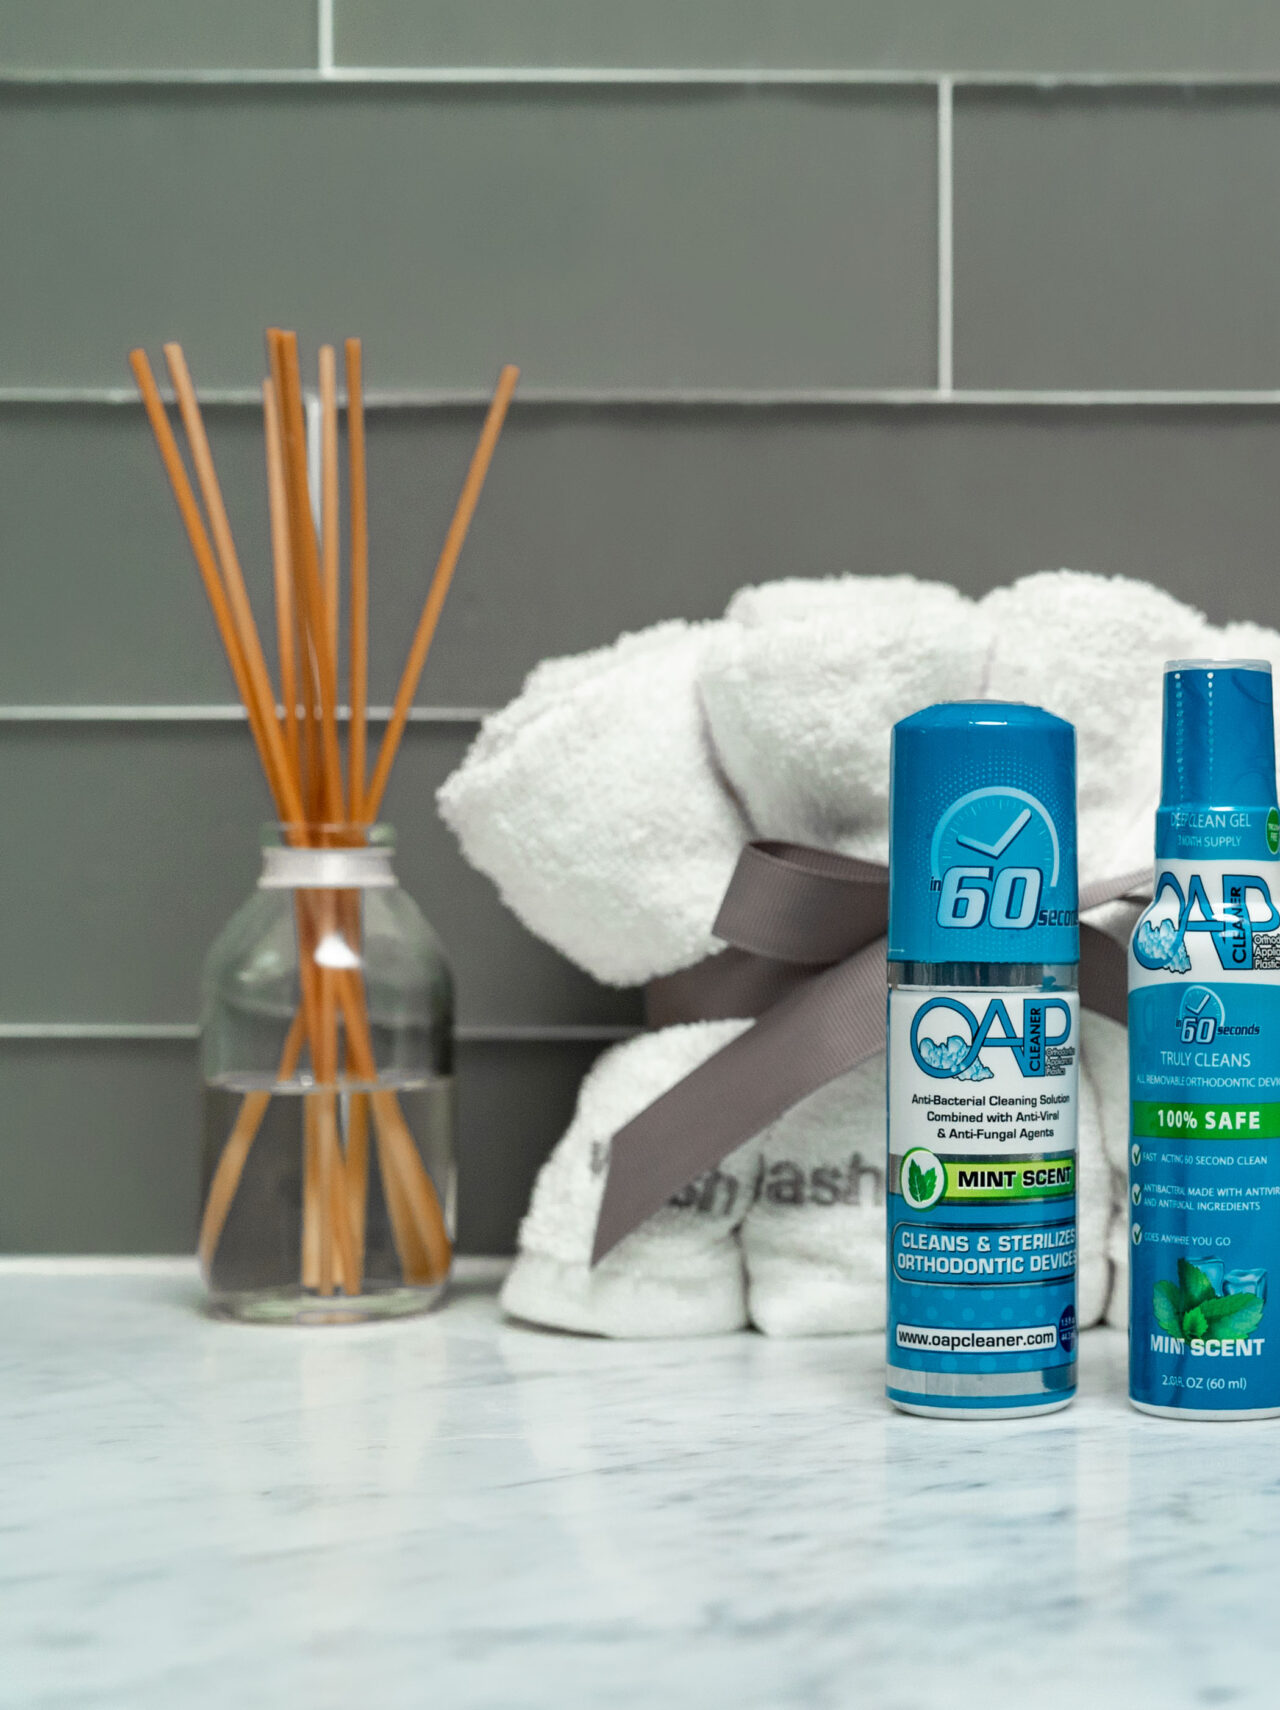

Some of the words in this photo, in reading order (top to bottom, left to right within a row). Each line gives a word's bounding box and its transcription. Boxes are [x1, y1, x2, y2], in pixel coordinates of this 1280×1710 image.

[1189, 814, 1227, 828] CLEAN
[1230, 813, 1251, 828] GEL
[1204, 836, 1242, 848] SUPPLY
[930, 876, 941, 892] in
[936, 866, 1043, 929] 60
[1133, 871, 1280, 970] OAP
[1230, 885, 1248, 964] CLEANER
[910, 997, 1072, 1078] OAP
[1175, 1018, 1182, 1028] in
[1180, 1016, 1217, 1044] 60
[1217, 1024, 1260, 1036] seconds
[1029, 1007, 1042, 1072] CLEANER
[1161, 1051, 1191, 1066] TRULY
[1194, 1053, 1250, 1068] CLEANS
[1146, 1074, 1185, 1086] REMOVABLE
[1186, 1077, 1256, 1088] ORTHODONTIC
[912, 1094, 986, 1107] Anti-Bacterial
[989, 1095, 1037, 1108] Cleaning
[1040, 1094, 1070, 1105] Solution
[927, 1111, 983, 1123] Combined
[986, 1112, 1013, 1123] with
[1016, 1110, 1059, 1122] Anti-Viral
[1158, 1110, 1198, 1129] 100%
[1205, 1111, 1260, 1130] SAFE
[937, 1129, 946, 1138] &
[949, 1129, 1016, 1142] Anti-Fungal
[1020, 1128, 1054, 1140] Agents
[1195, 1156, 1234, 1165] SECOND
[1237, 1156, 1268, 1165] CLEAN
[958, 1171, 1017, 1188] MINT
[1022, 1166, 1072, 1187] SCENT
[1188, 1188, 1214, 1197] MADE
[1217, 1188, 1242, 1197] WITH
[1197, 1202, 1261, 1211] INGREDIENTS
[902, 1231, 969, 1252] CLEANS
[977, 1236, 990, 1252] &
[998, 1229, 1076, 1252] STERILIZES
[1192, 1237, 1212, 1246] YOU
[1215, 1237, 1231, 1247] GO
[897, 1253, 1024, 1274] ORTHODONTIC
[1030, 1249, 1077, 1272] DEVICES
[898, 1330, 1054, 1351] www.oapcleaner.com
[1150, 1334, 1185, 1355] MINT
[1190, 1338, 1265, 1357] SCENT
[1186, 1377, 1203, 1389] OZ
[1206, 1377, 1225, 1391] (60
[1228, 1377, 1247, 1391] ml)
